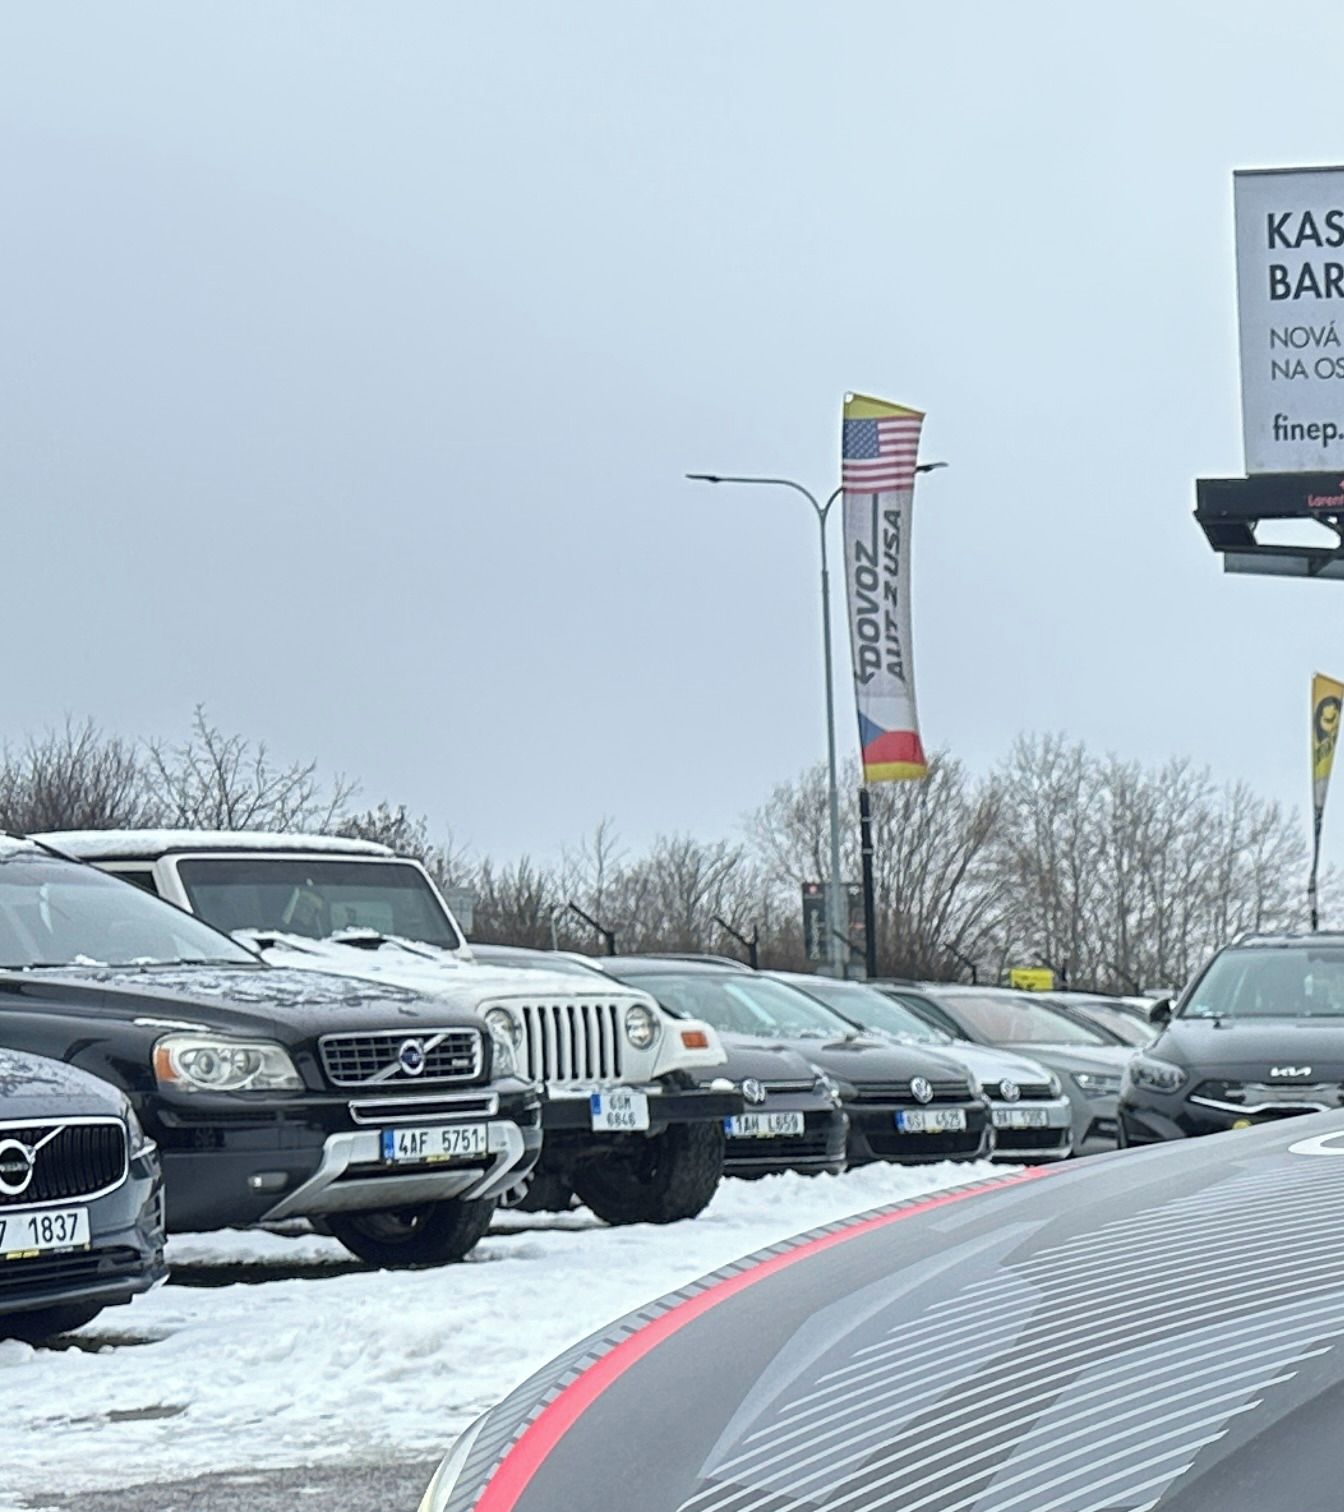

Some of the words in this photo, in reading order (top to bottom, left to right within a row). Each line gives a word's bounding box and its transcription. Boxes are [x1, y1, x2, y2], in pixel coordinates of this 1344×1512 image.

[1269, 320, 1341, 349] NOVÁ
[1271, 359, 1309, 381] NA
[883, 509, 902, 577] USA
[855, 540, 882, 685] DOVOZ
[398, 1131, 429, 1155] 4AF
[441, 1128, 480, 1153] 5751
[28, 1212, 78, 1245] 1837
